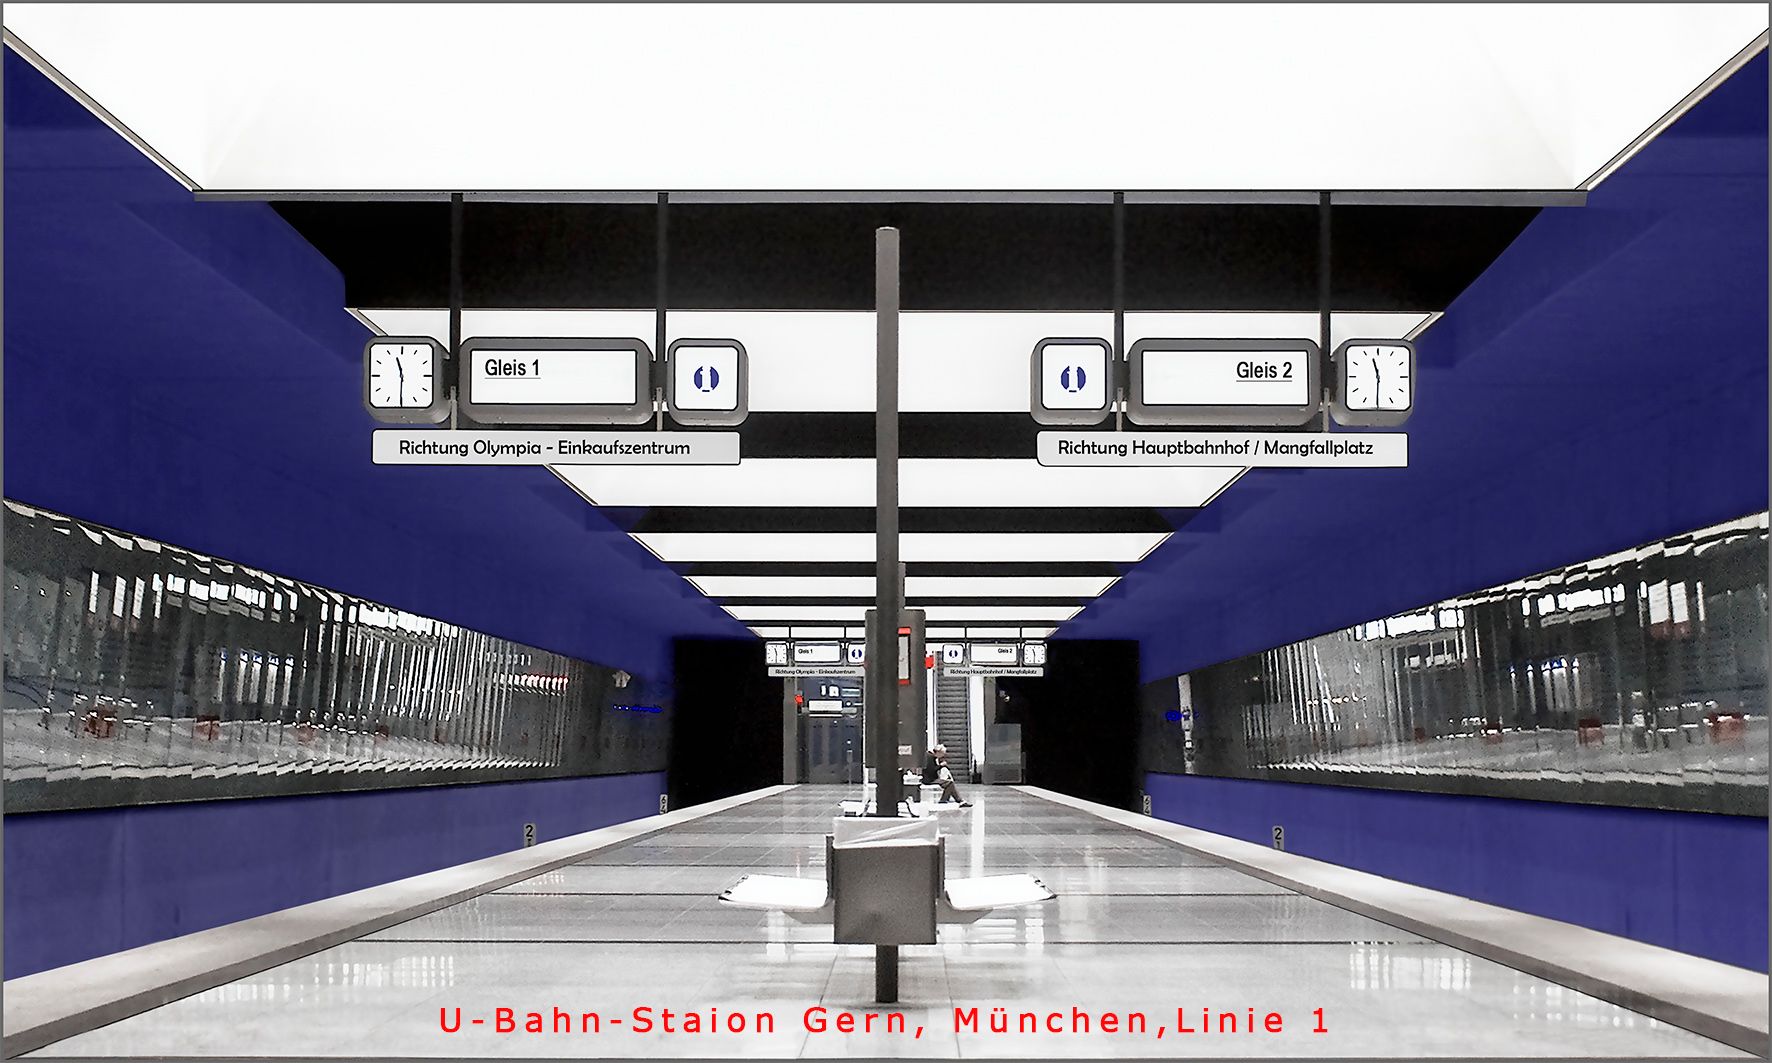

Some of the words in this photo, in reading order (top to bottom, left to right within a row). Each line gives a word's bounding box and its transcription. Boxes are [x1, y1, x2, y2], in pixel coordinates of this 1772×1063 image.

[484, 358, 527, 376] Gleis
[532, 358, 539, 376] 1
[1236, 361, 1278, 379] Gleis
[1282, 361, 1293, 379] 2
[399, 439, 469, 457] Richtung
[473, 439, 542, 458] Olympia
[558, 439, 691, 455] Einkaufszentrum
[1058, 439, 1128, 457] Richtung
[1132, 439, 1250, 458] Hauptbahnhof
[1253, 440, 1260, 456] /
[1264, 439, 1374, 458] Mangfallplatz
[525, 824, 534, 838] 2
[1274, 827, 1283, 840] 2
